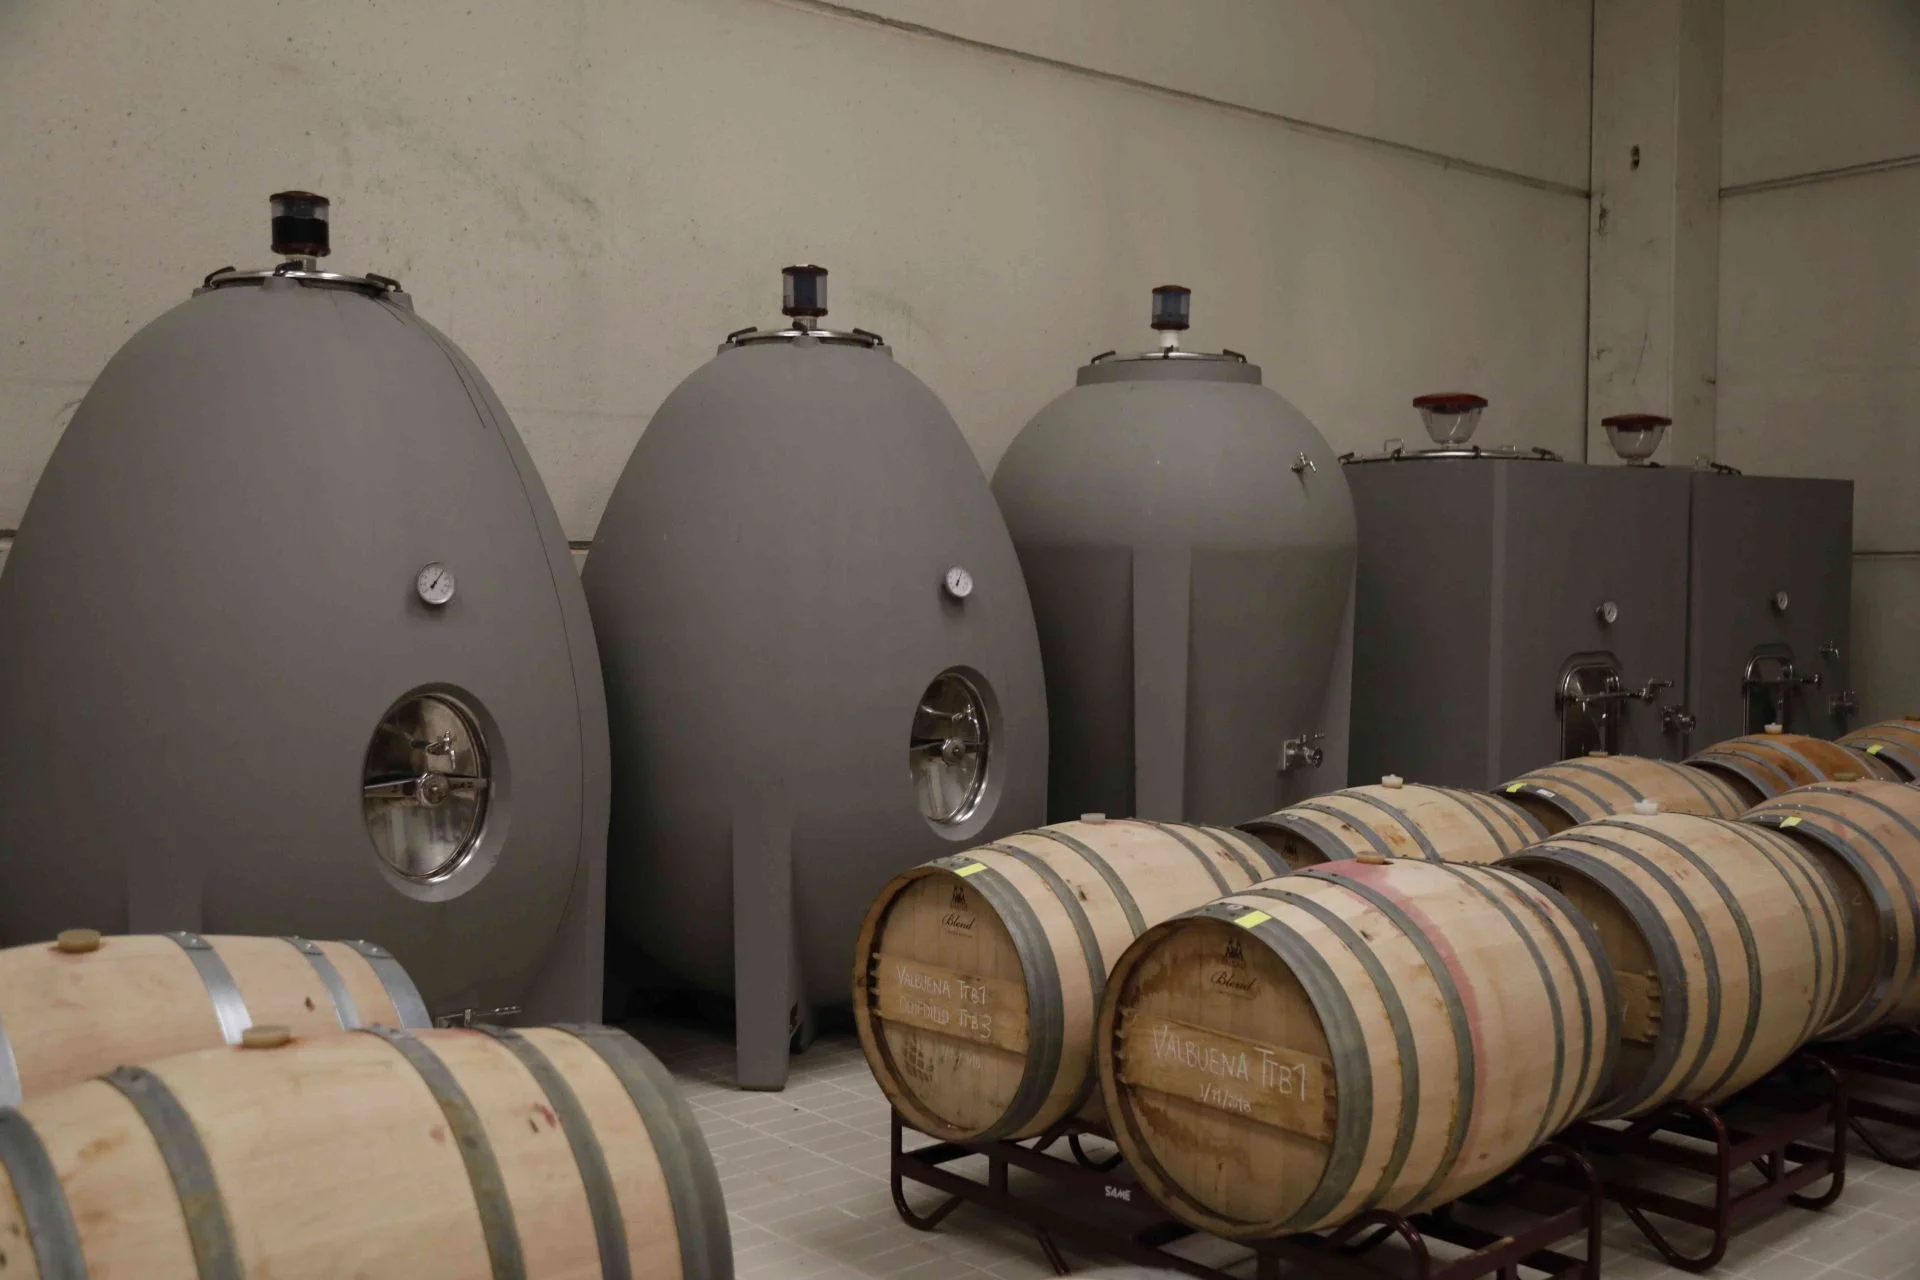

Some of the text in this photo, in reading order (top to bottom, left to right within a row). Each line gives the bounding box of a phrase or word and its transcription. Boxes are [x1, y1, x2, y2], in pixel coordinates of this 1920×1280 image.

[896, 964, 951, 999] VALBUENA
[1210, 970, 1258, 991] Blend
[1152, 1023, 1249, 1082] VALBUENA
